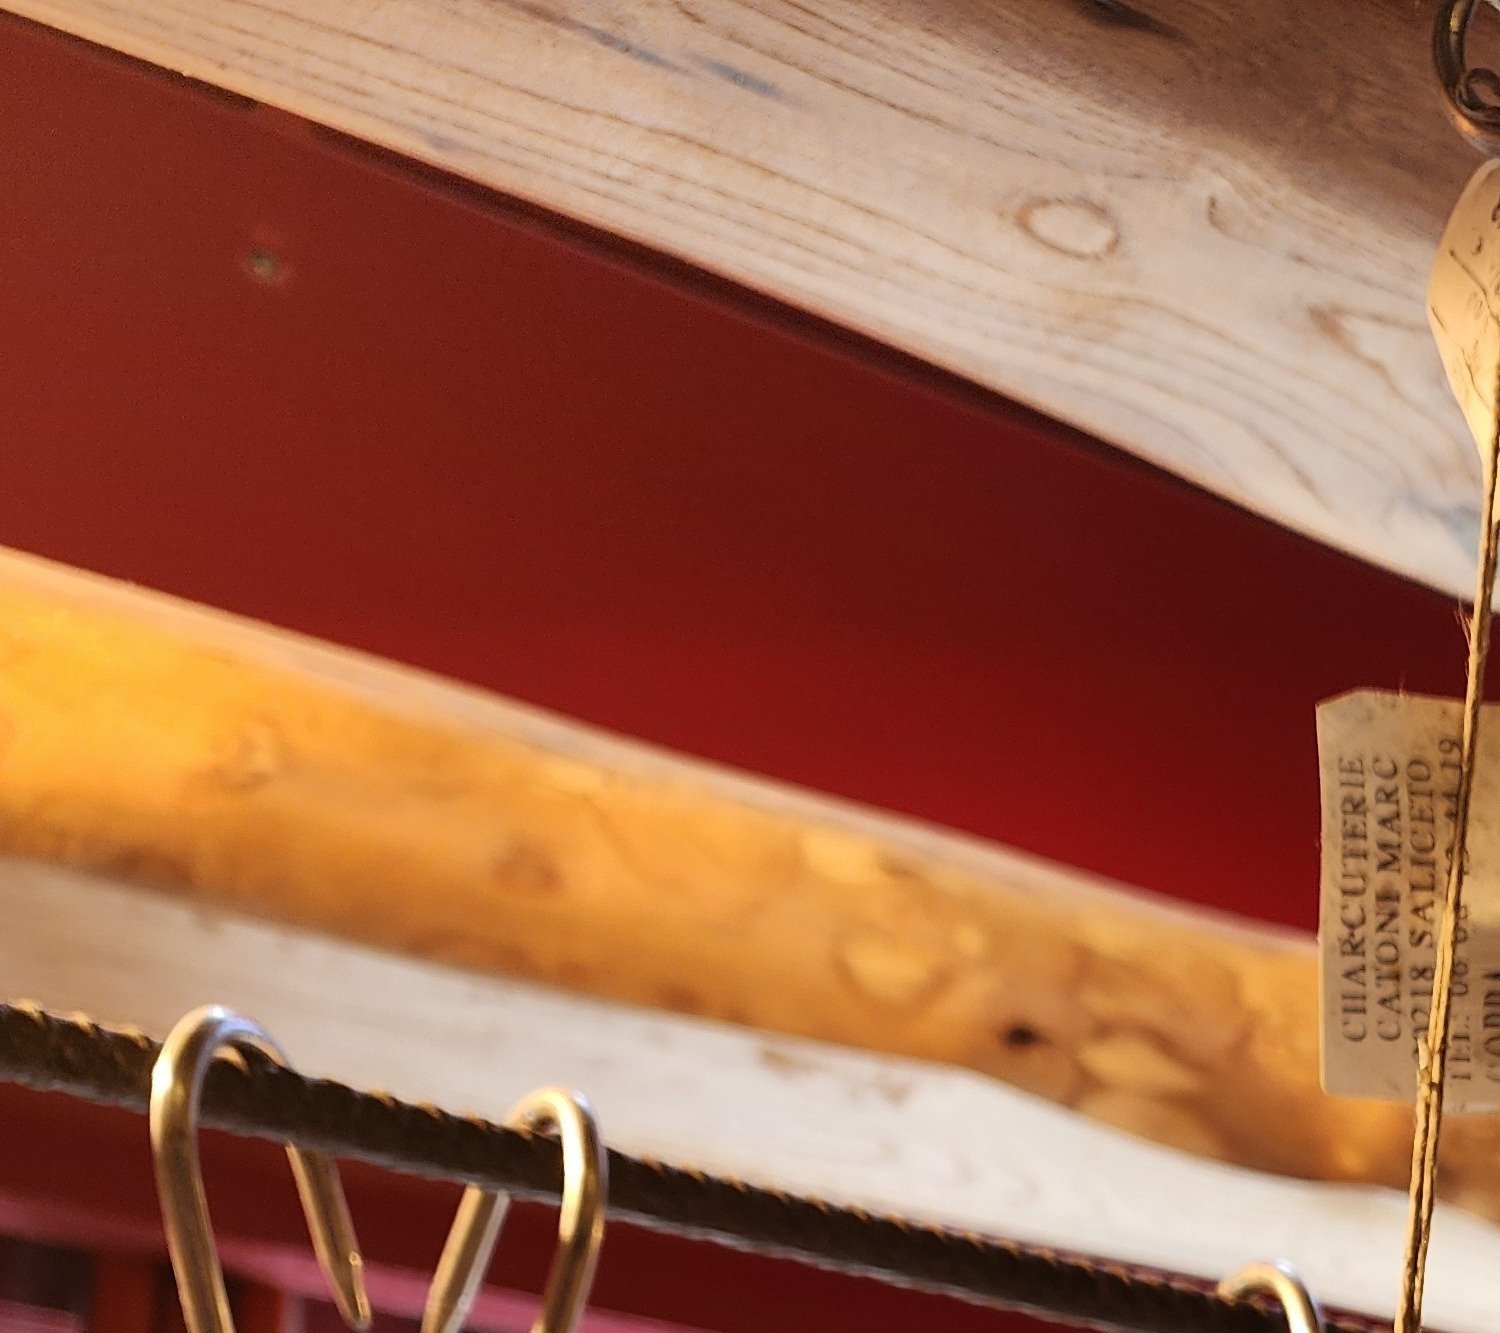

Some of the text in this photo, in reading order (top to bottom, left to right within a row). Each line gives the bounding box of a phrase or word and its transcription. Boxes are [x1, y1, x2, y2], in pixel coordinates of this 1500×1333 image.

[1339, 756, 1368, 1042] CHARCUTERIE
[1372, 756, 1401, 1042] CATONI MARC
[1407, 758, 1436, 949] SALICETO
